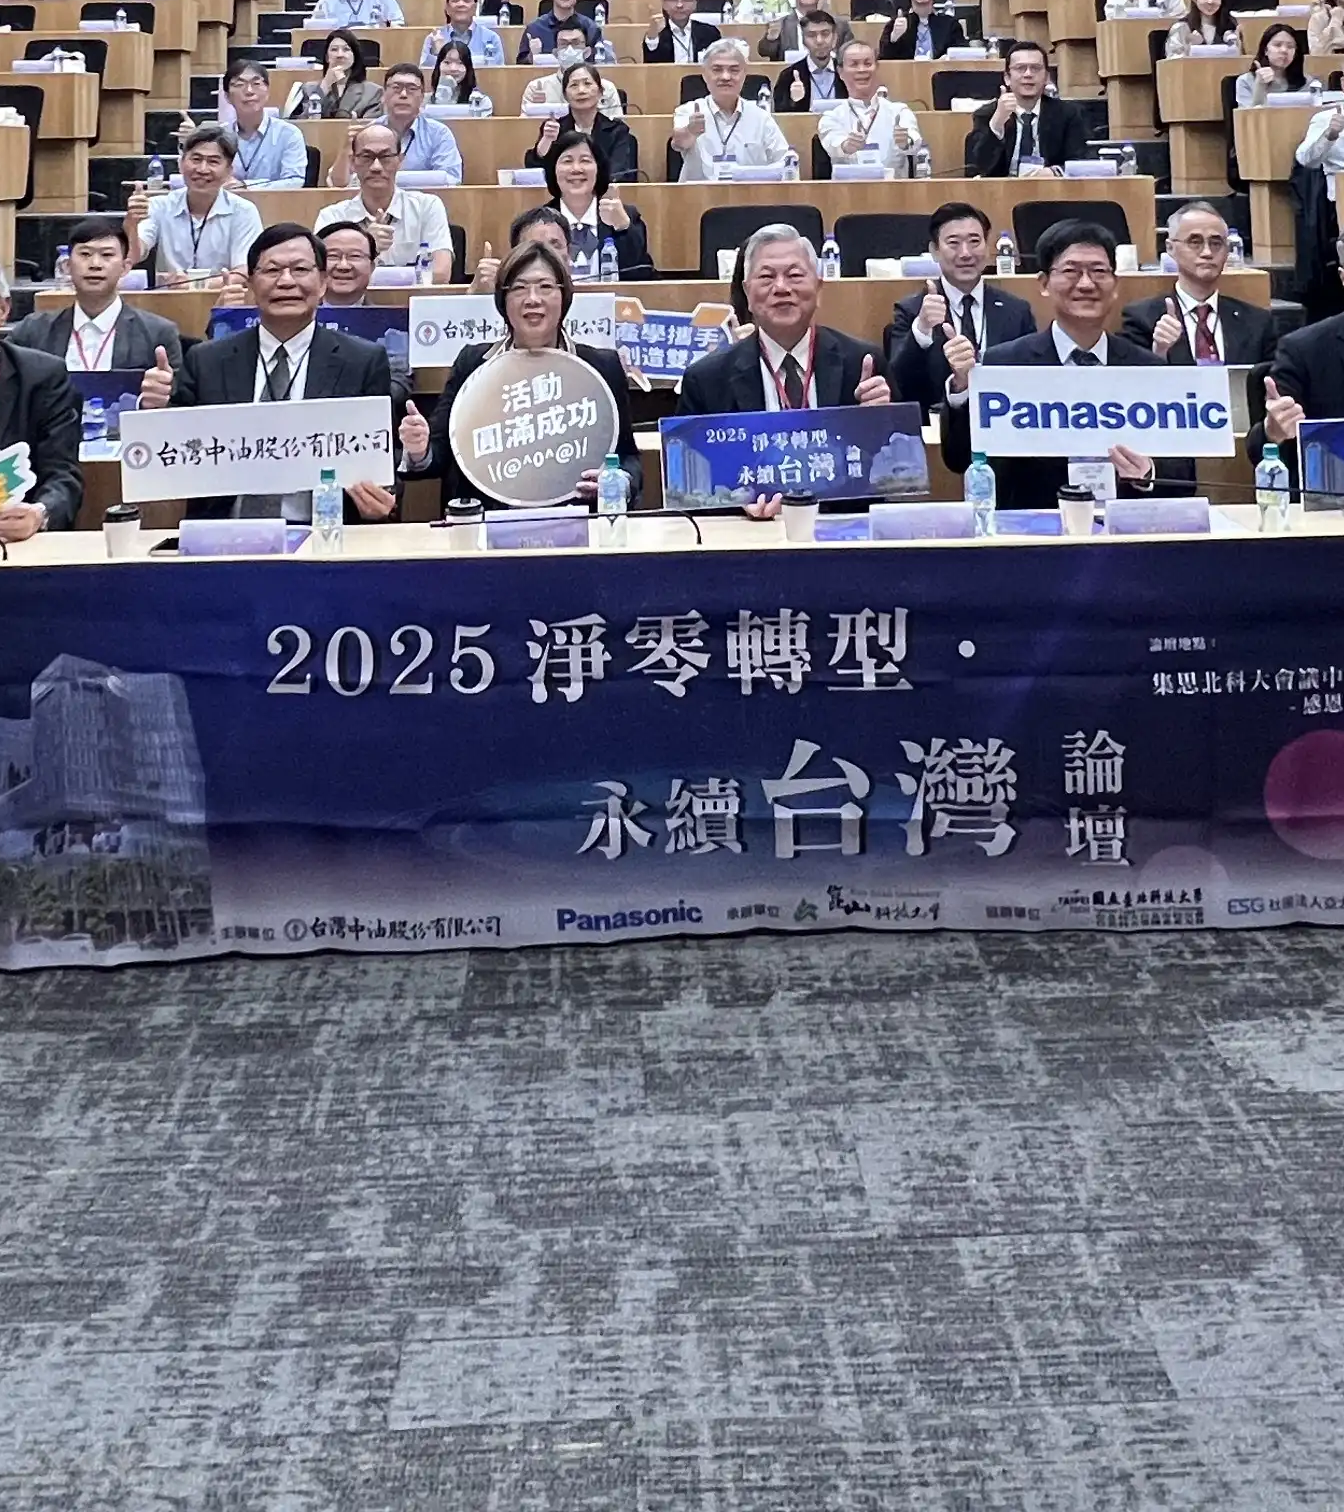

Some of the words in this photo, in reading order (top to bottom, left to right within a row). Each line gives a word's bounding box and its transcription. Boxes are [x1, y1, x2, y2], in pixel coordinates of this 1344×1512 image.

[501, 371, 562, 413] 活動
[978, 391, 1228, 429] Panasonic
[472, 397, 598, 459] 圓滿成功
[706, 427, 747, 444] 2025
[157, 429, 390, 467] 台灣中油股份有限公司
[266, 623, 496, 697] 2025
[1062, 729, 1130, 868] 論壇
[557, 899, 704, 932] Panasonic
[1058, 896, 1090, 905] TAIPEI
[1227, 897, 1265, 915] ESG
[310, 915, 501, 941] 台灣中油股份有限公司
